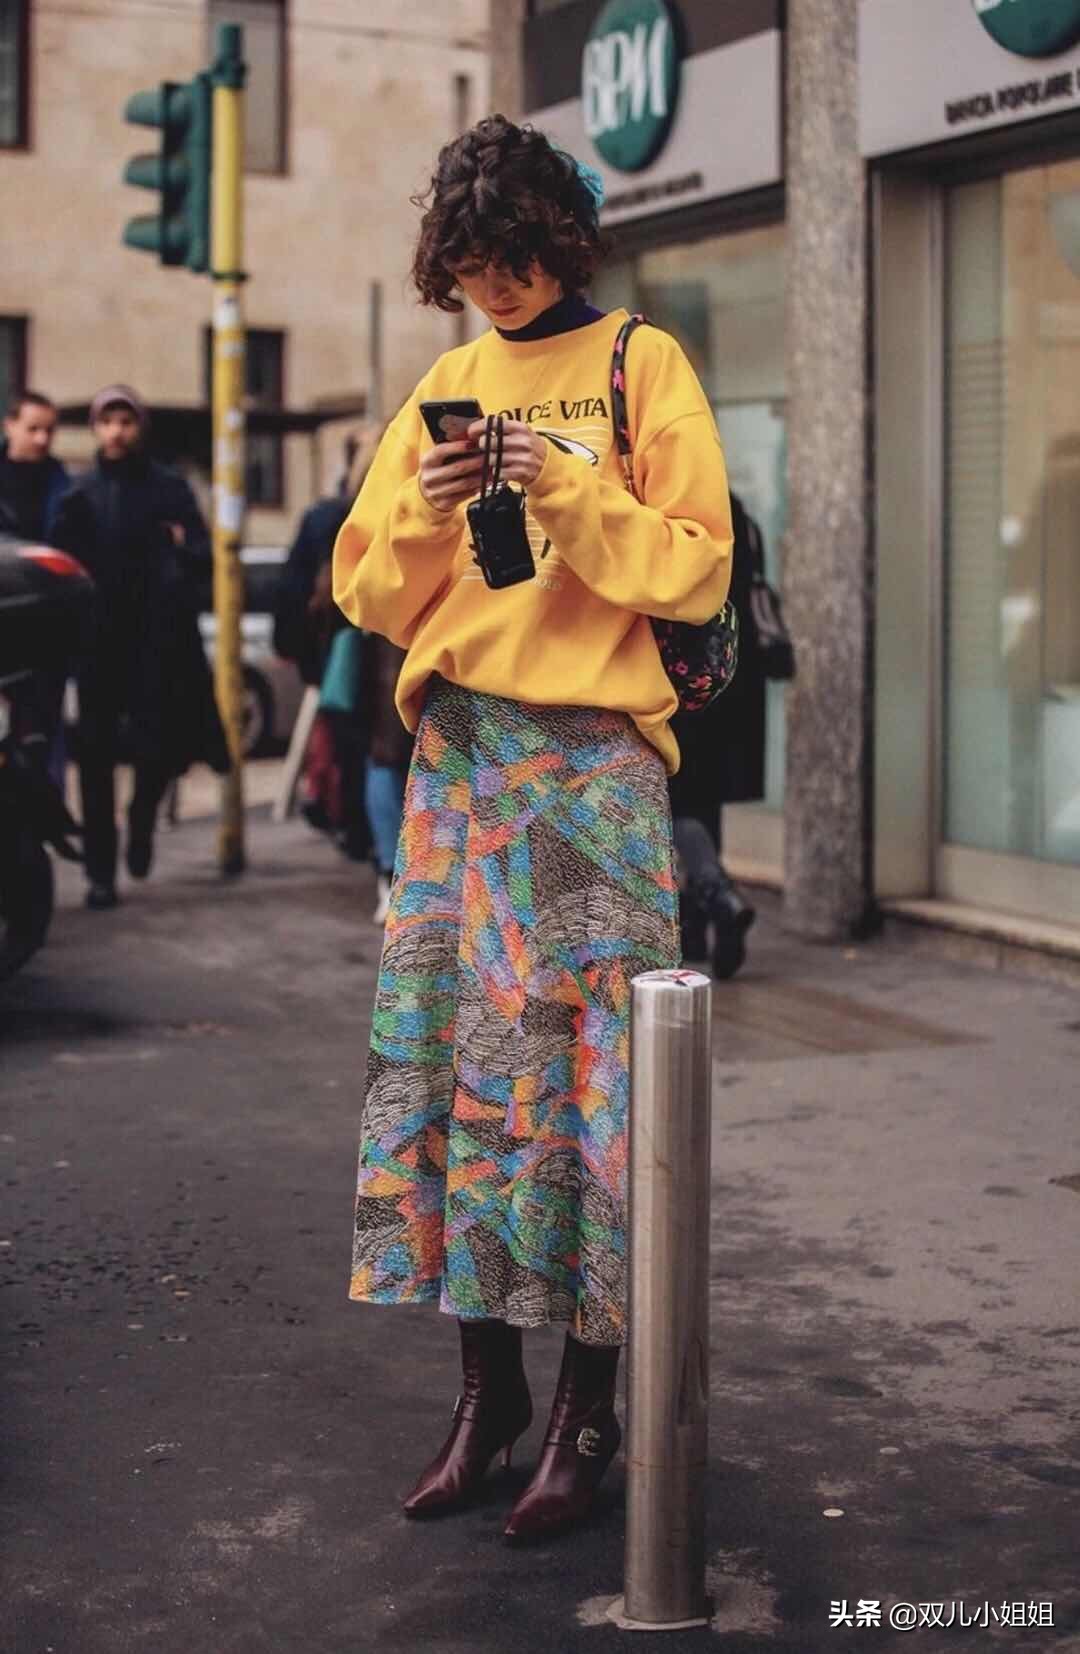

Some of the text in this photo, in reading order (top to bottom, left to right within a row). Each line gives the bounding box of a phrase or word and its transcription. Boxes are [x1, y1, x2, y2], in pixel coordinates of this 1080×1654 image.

[580, 16, 669, 136] BPM
[487, 398, 609, 424] OLCE VITA
